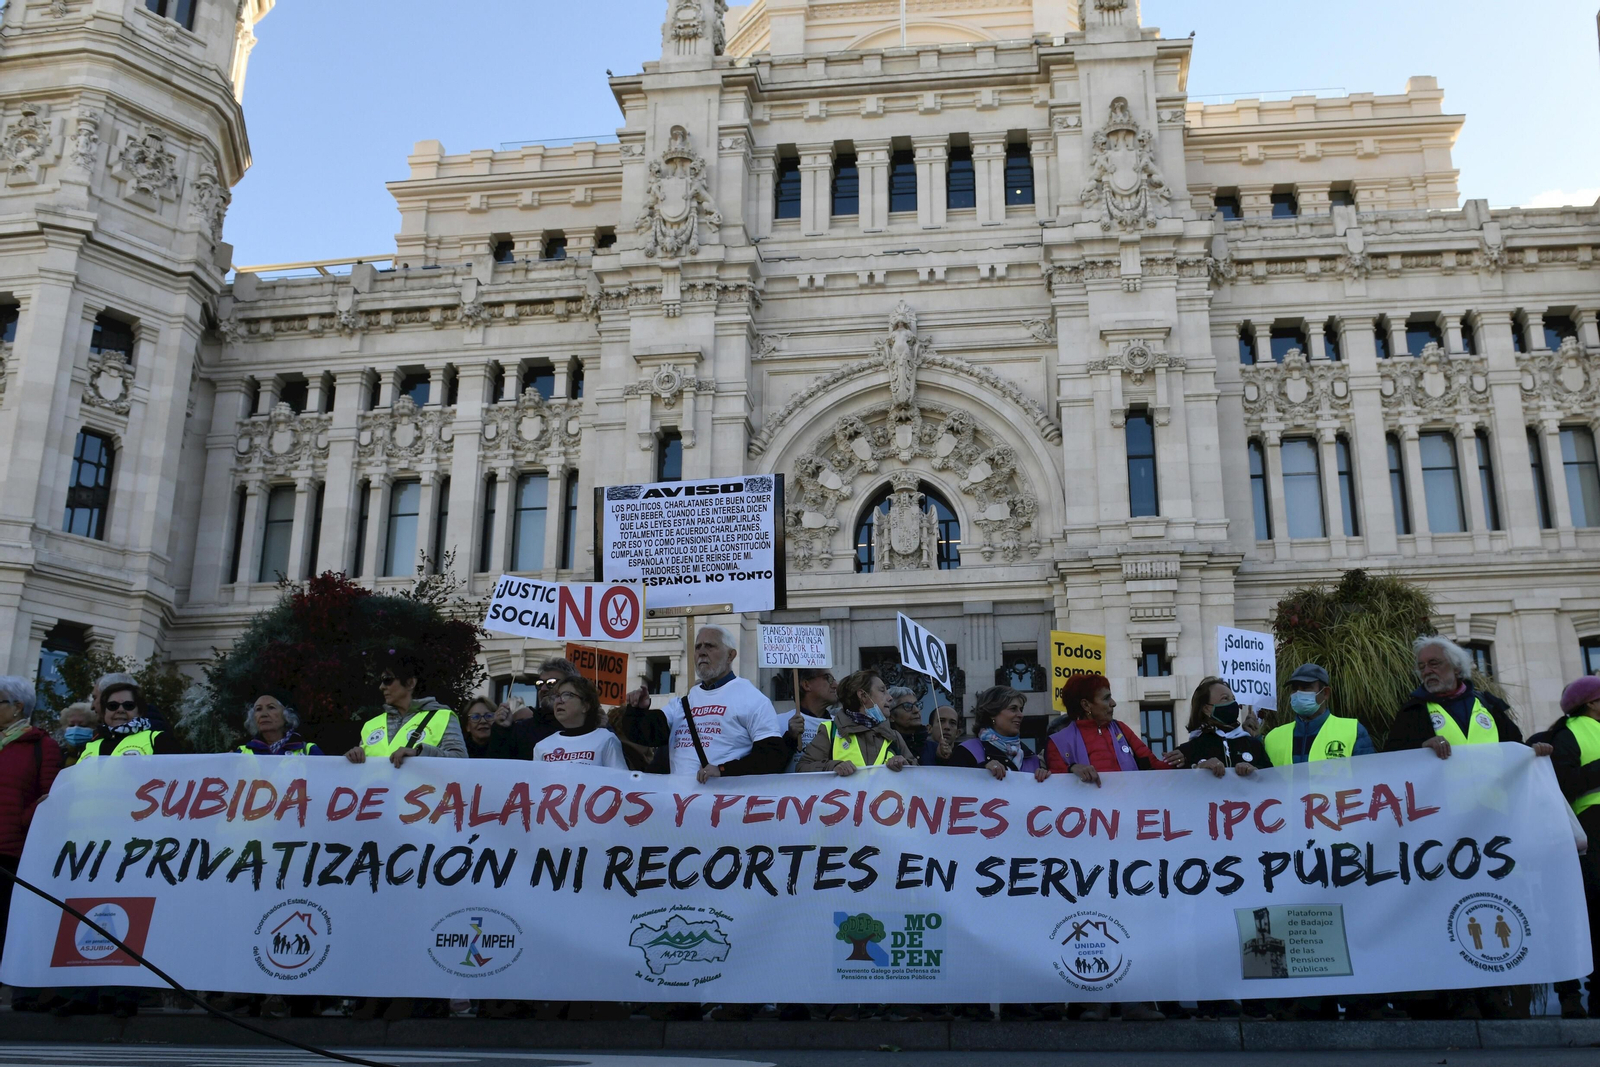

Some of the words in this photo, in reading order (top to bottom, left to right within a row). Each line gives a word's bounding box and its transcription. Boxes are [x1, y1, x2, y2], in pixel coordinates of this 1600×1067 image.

[642, 482, 744, 499] AVISO
[612, 504, 624, 513] LOS
[626, 501, 662, 512] POLÍTICOS,
[664, 498, 713, 509] CHARLATANES
[715, 497, 724, 506] DE
[726, 496, 744, 505] BUEN
[746, 494, 771, 504] COMER
[615, 513, 620, 522] Y
[621, 512, 639, 521] BUEN
[641, 511, 665, 520] BEBER,
[667, 508, 695, 518] CUANDO
[697, 507, 710, 516] LES
[712, 505, 745, 515] INTERESA
[747, 504, 767, 513] DICEN
[620, 521, 634, 531] QUE
[636, 520, 648, 530] LAS
[650, 519, 671, 529] LEYES
[697, 516, 715, 525] PARA
[612, 541, 627, 550] POR
[628, 540, 642, 549] ESO
[644, 539, 653, 548] YO
[655, 538, 675, 547] COMO
[677, 534, 720, 545] PENSIONISTA
[722, 533, 735, 542] LES
[737, 532, 753, 542] PIDO
[755, 531, 769, 540] QUE
[620, 529, 663, 539] TOTALMENTE
[665, 528, 674, 537] DE
[675, 526, 709, 537] ACUERDO
[611, 549, 643, 559] CUMPLAN
[645, 548, 653, 557] EL
[690, 545, 697, 554] 50
[699, 544, 708, 553] DE
[710, 543, 719, 553] LA
[720, 540, 771, 552] CONSTITUCIÓN
[628, 556, 664, 567] ESPAÑOLA
[665, 556, 670, 565] Y
[671, 555, 693, 565] DEJEN
[695, 554, 704, 563] DE
[732, 552, 742, 561] DE
[641, 565, 680, 576] TRAIDORES
[681, 565, 691, 574] DE
[693, 564, 700, 573] MI
[642, 574, 701, 586] ESPAÑOL
[705, 573, 724, 583] NO
[728, 570, 773, 581] TONTO
[496, 580, 557, 603] ¡JUSTIC
[557, 585, 640, 639] NO
[763, 626, 786, 636] PLANES
[763, 635, 773, 644] EN
[774, 635, 793, 644] FORUM
[798, 636, 823, 645] AFINSA
[763, 643, 790, 652] ROBADOS
[793, 644, 807, 652] POR
[810, 644, 821, 653] EL
[1224, 634, 1264, 651] ¡Salario
[766, 652, 800, 665] ESTADO
[900, 616, 948, 684] NO
[1054, 641, 1102, 660] Todos
[1221, 660, 1228, 671] y
[1231, 658, 1271, 675] pensión
[130, 777, 312, 828] SUBIDA
[327, 786, 389, 821] DE
[398, 781, 655, 833] SALARIOS
[674, 792, 703, 828] Y
[710, 787, 1010, 839] PENSIONES
[1026, 804, 1120, 841] CON
[1136, 808, 1193, 842] EL
[1208, 797, 1289, 841] IPC
[1301, 780, 1441, 831] REAL
[52, 839, 111, 883] NI
[115, 833, 518, 894] PRIVATIZACIÓN
[529, 846, 588, 894] NI
[602, 844, 879, 897] RECORTES
[894, 851, 958, 894] EN
[974, 855, 1245, 904] SERVICIOS
[1259, 835, 1517, 893] PÚBLICOS
[254, 901, 287, 935] Coordinadora
[321, 910, 332, 935] Defensa
[1287, 909, 1333, 917] Plataforma
[1447, 903, 1461, 942] PLATAFORMA
[1458, 892, 1503, 905] PENSIONISTAS
[1503, 897, 1513, 906] DE
[1465, 903, 1504, 916] PENSIONISTAS
[904, 912, 942, 931] MO
[1049, 913, 1077, 940] Coordinadora
[1113, 919, 1131, 939] Defensa
[1301, 919, 1334, 927] Badajoz
[435, 933, 469, 948] EHPM
[481, 934, 515, 949] MPEH
[890, 931, 923, 948] DE
[254, 956, 274, 977] Sistema
[273, 971, 298, 981] Público
[299, 971, 307, 979] de
[307, 944, 331, 975] Pensiones
[890, 949, 943, 967] PEN
[1290, 956, 1336, 964] Pensiones
[1459, 950, 1505, 973] PENSIONES
[1505, 946, 1529, 970] DIGNAS
[1292, 965, 1329, 973] Públicas
[1058, 970, 1080, 989] Sistema
[1105, 982, 1114, 990] de
